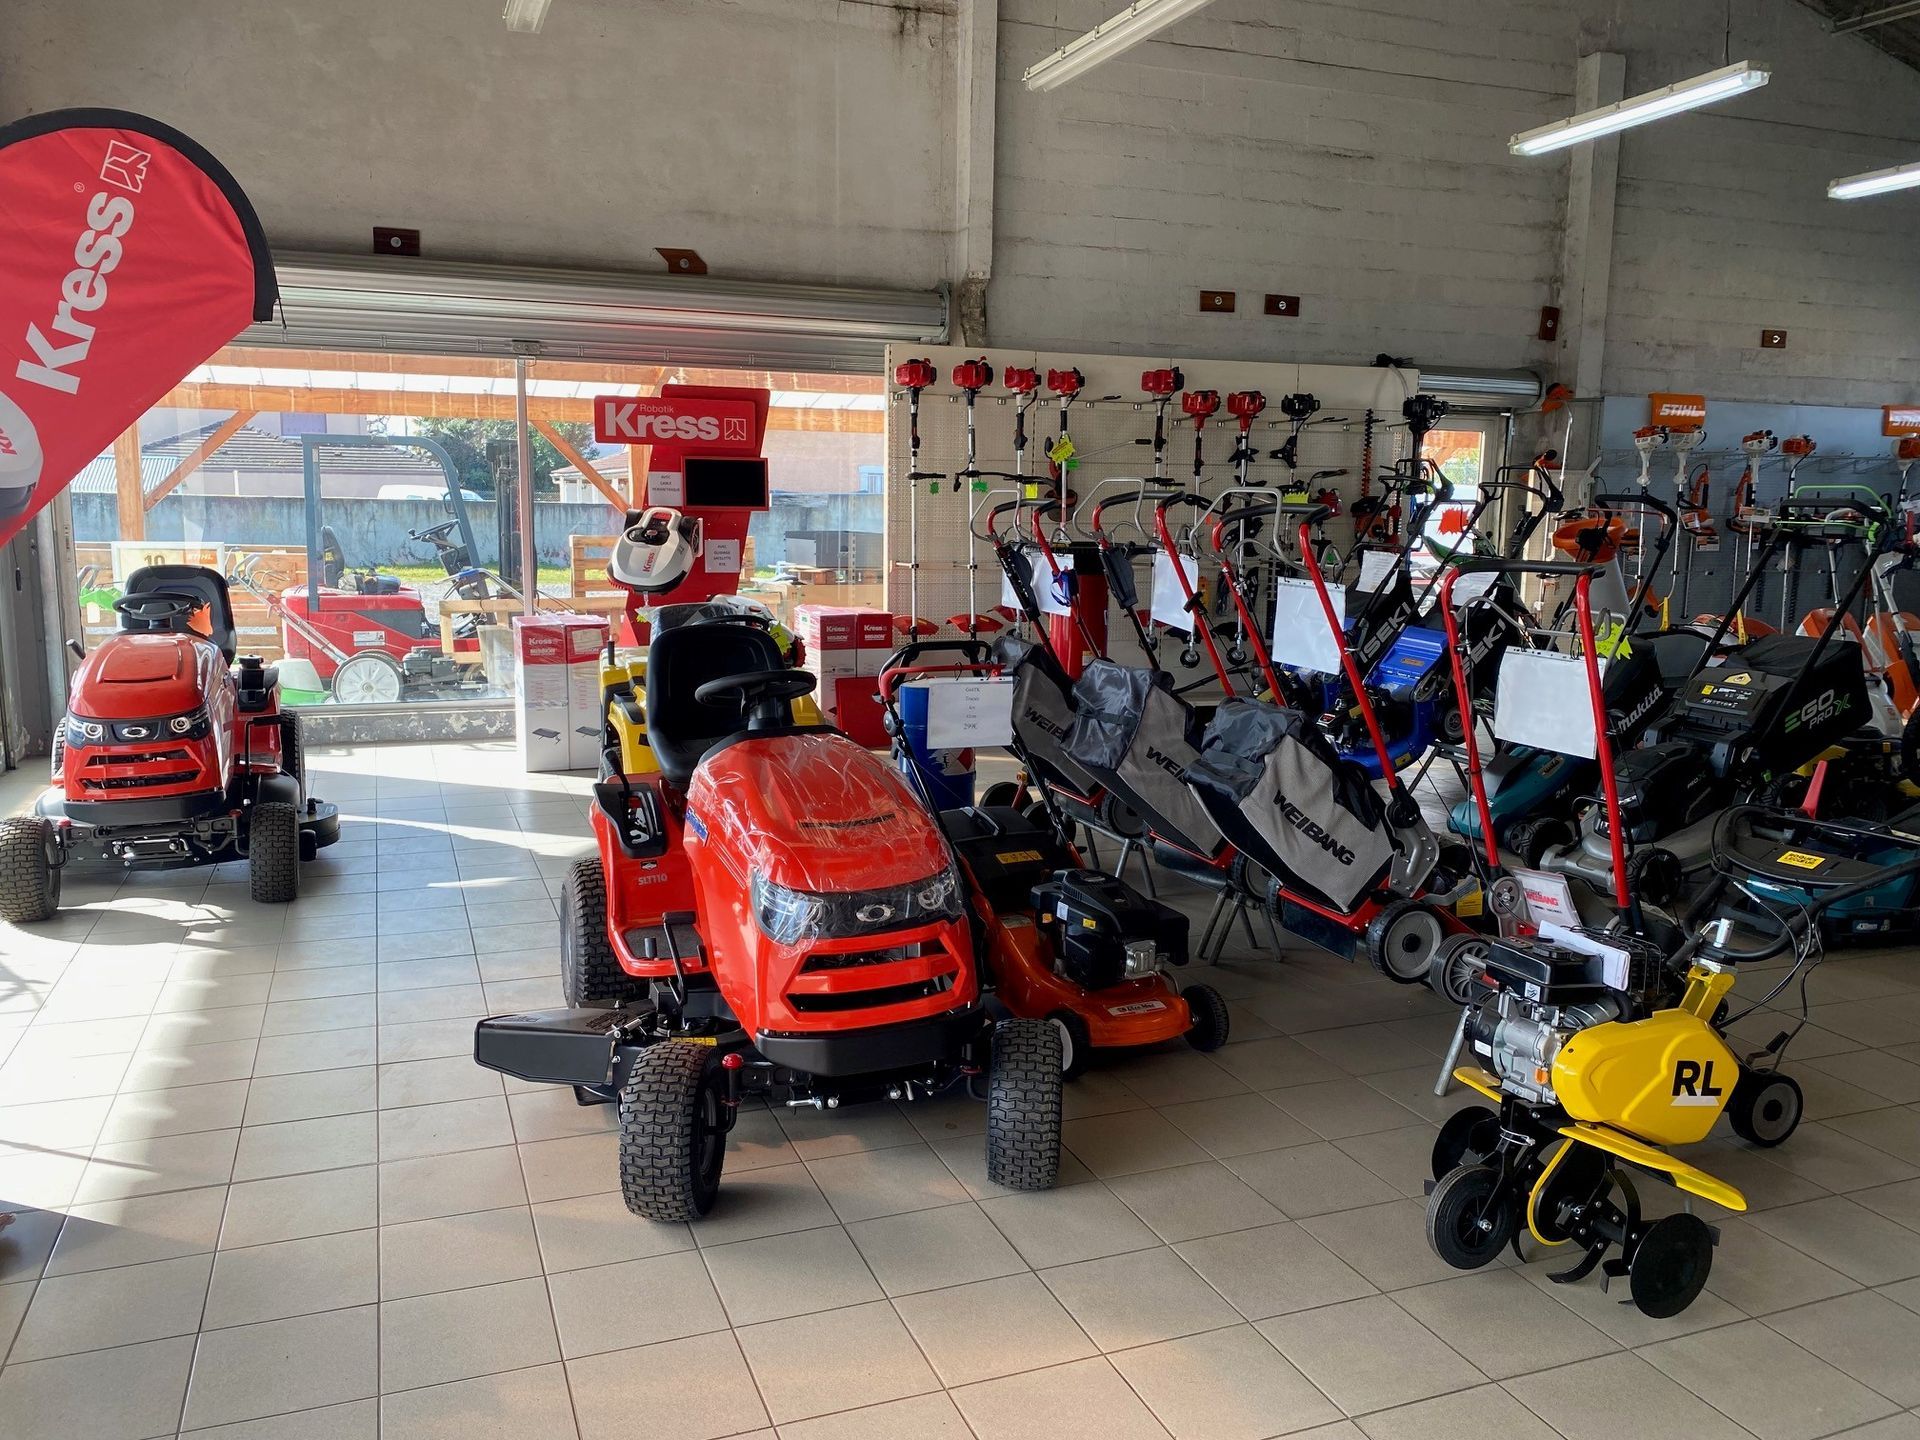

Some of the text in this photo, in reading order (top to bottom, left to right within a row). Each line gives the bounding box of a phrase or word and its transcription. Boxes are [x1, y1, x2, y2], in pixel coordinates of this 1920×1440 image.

[15, 191, 135, 395] Kress
[604, 402, 720, 441] Kress
[640, 403, 675, 413] Robotik
[1660, 403, 1706, 417] STIHL
[642, 551, 656, 573] Kress
[1358, 601, 1412, 663] ISEKI
[1461, 618, 1507, 677] SEKI
[1024, 706, 1068, 745] WEIB
[1617, 685, 1663, 733] makita
[1785, 689, 1835, 734] EGO
[1808, 706, 1834, 730] PRO
[1273, 789, 1356, 867] WEIBANG
[1671, 1060, 1722, 1097] RL
